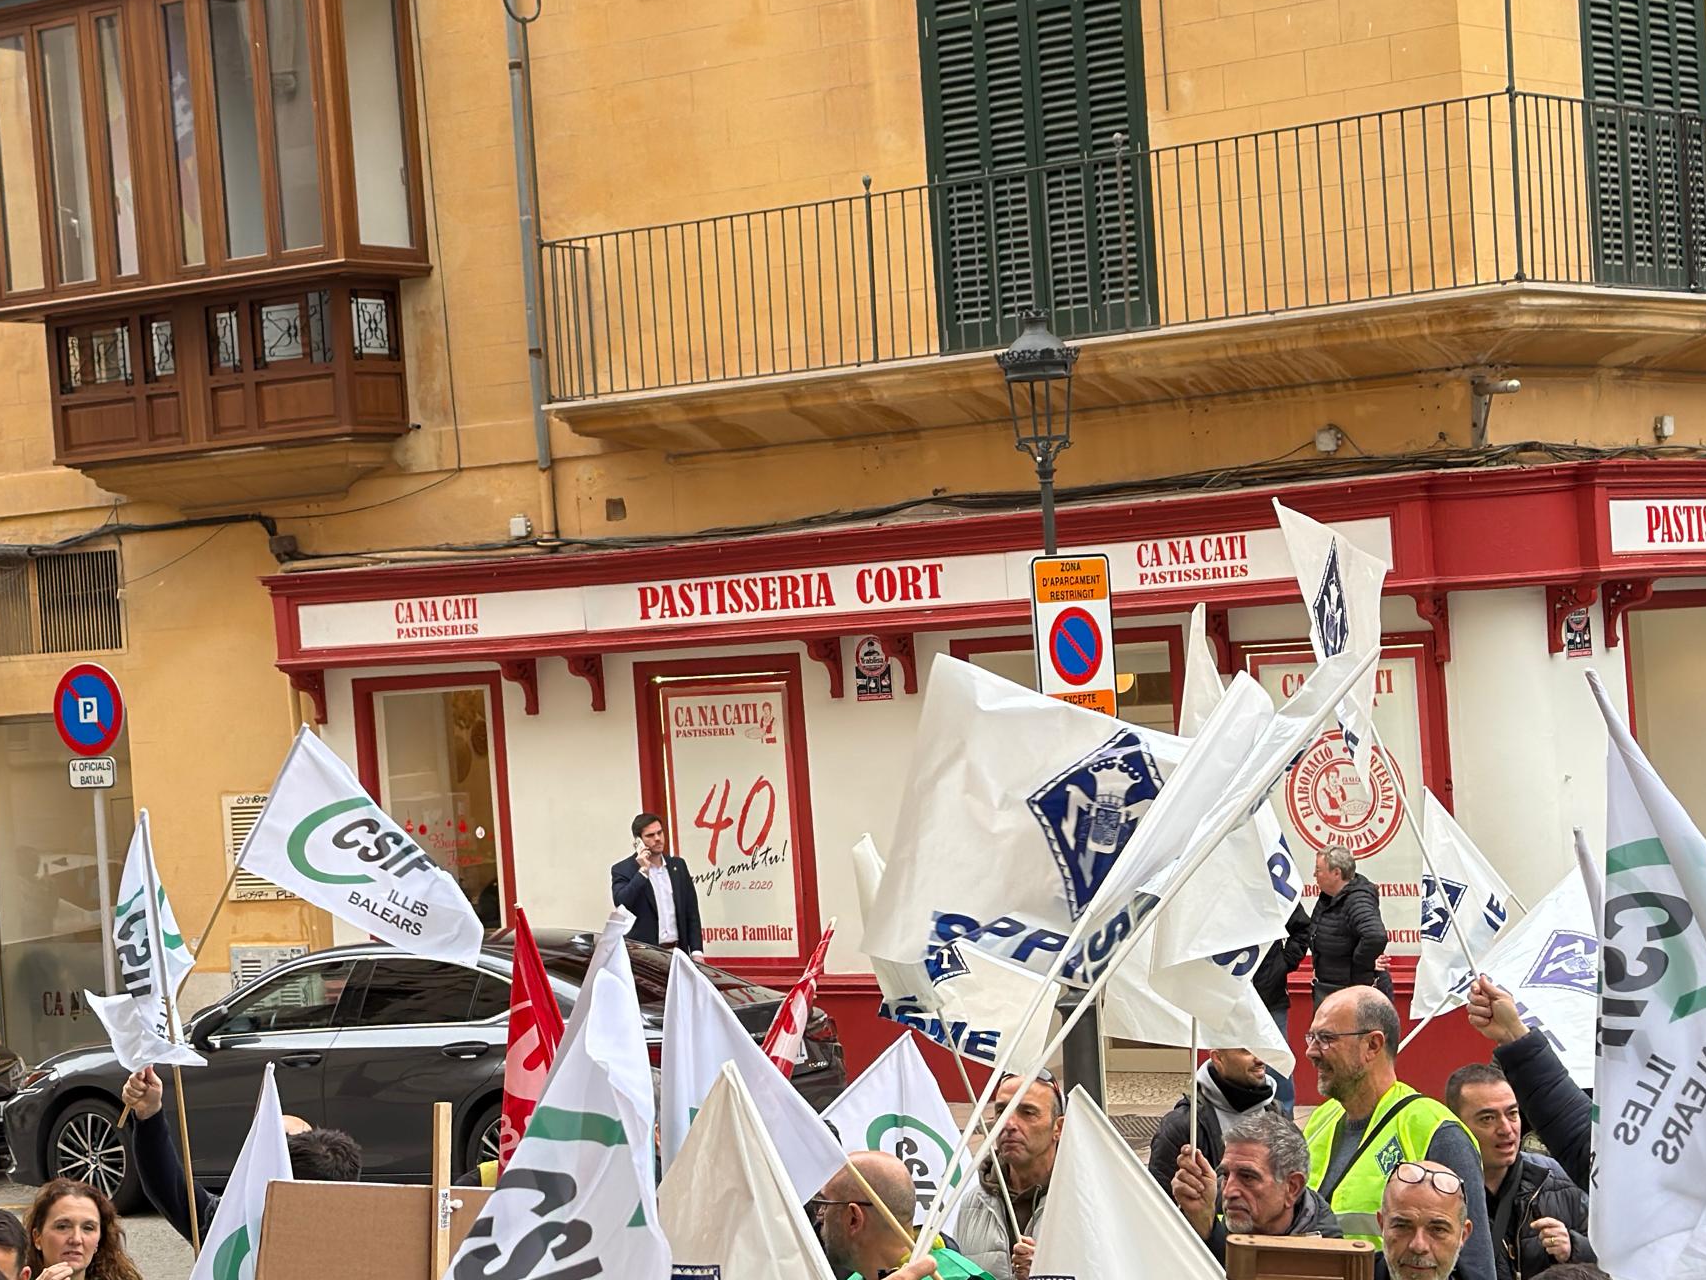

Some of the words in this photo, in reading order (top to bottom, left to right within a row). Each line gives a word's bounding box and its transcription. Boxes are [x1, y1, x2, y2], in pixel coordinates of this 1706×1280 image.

[1137, 539, 1162, 568] CA
[1169, 537, 1195, 565] NA
[1200, 533, 1249, 563] CATI
[1060, 562, 1082, 572] ZONA
[1139, 564, 1249, 586] PASTISSERIES
[1042, 574, 1101, 587] D'APARCAMENT
[637, 572, 836, 621] PASTISSERIA
[855, 564, 944, 604] CORT
[1050, 588, 1095, 600] RESTRINGIT
[395, 602, 414, 624] CA
[419, 600, 439, 622] NA
[442, 597, 478, 621] CATI
[396, 623, 479, 640] PASTISSERIES
[1062, 693, 1097, 705] EXCEPTE
[674, 706, 695, 728] CA
[696, 704, 720, 727] NA
[721, 702, 759, 726] CATI
[675, 727, 735, 738] PASTISSERIA
[71, 762, 78, 771] V.
[78, 761, 111, 772] OFICIALS
[1370, 755, 1394, 811] RTESANA
[694, 775, 776, 866] 40
[332, 818, 438, 879] CSIF
[1326, 827, 1379, 850] PRÒPIA
[691, 869, 724, 897] nys
[727, 848, 759, 878] amb
[759, 840, 788, 868] tu!
[749, 879, 773, 890] 2020
[1376, 883, 1420, 898] RTESANA
[347, 890, 423, 937] BALEARS
[387, 889, 430, 918] ILLES
[701, 925, 739, 942] mpresa
[741, 924, 794, 941] Familiar
